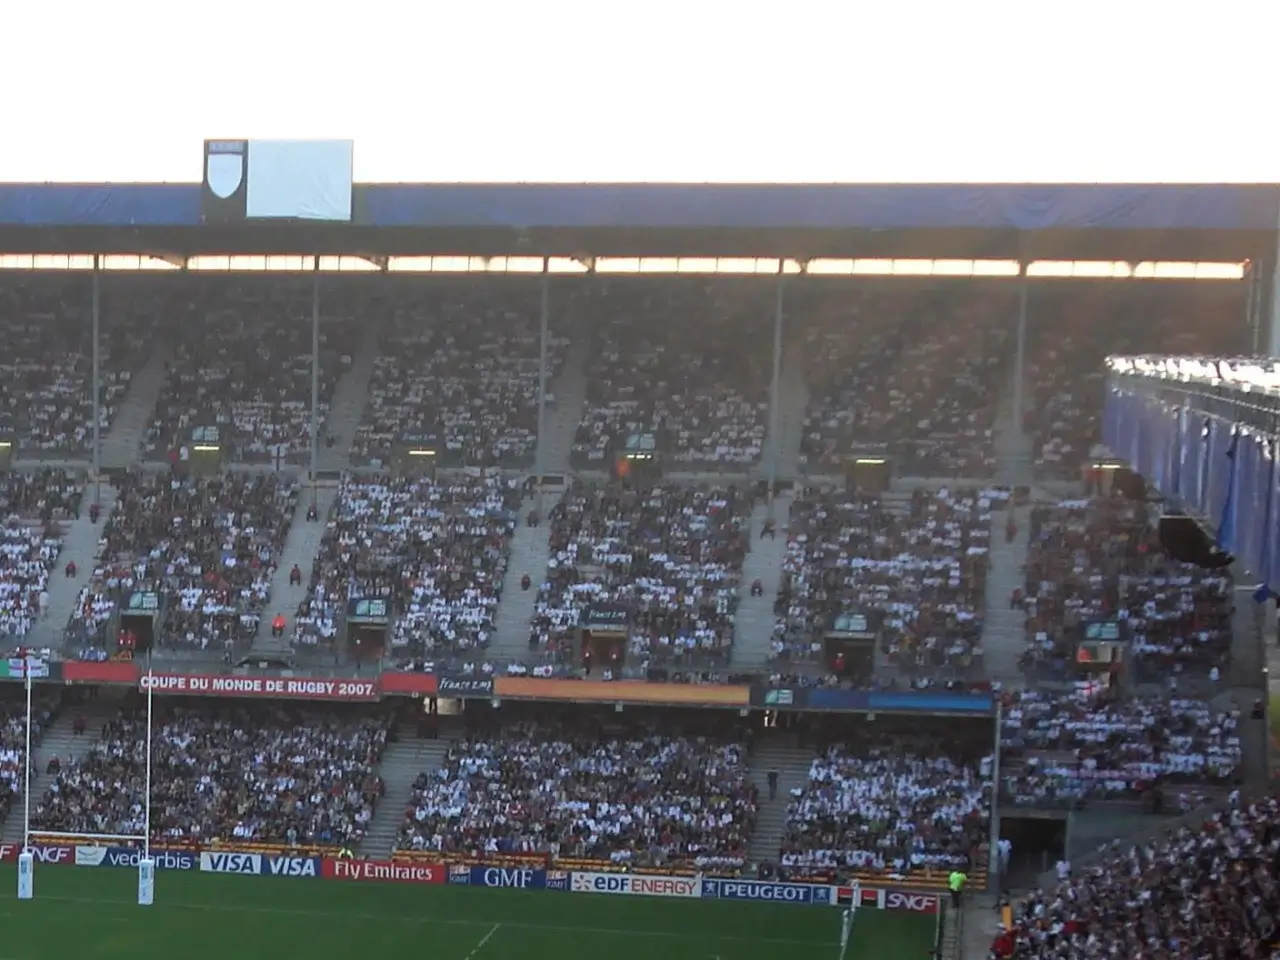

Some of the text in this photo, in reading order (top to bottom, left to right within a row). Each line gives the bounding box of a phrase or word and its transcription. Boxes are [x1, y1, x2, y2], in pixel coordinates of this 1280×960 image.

[140, 675, 185, 689] COUPE
[190, 678, 208, 690] DU
[212, 678, 262, 691] MONDE
[265, 680, 283, 692] DE
[287, 681, 334, 694] RUGBY
[209, 854, 255, 873] VISA
[269, 857, 316, 876] VISA
[335, 860, 433, 881] Fly Emirates
[484, 867, 533, 888] GMF
[631, 878, 696, 895] ENERGY
[723, 885, 808, 900] PEUGEOT
[887, 892, 936, 911] SNCF
